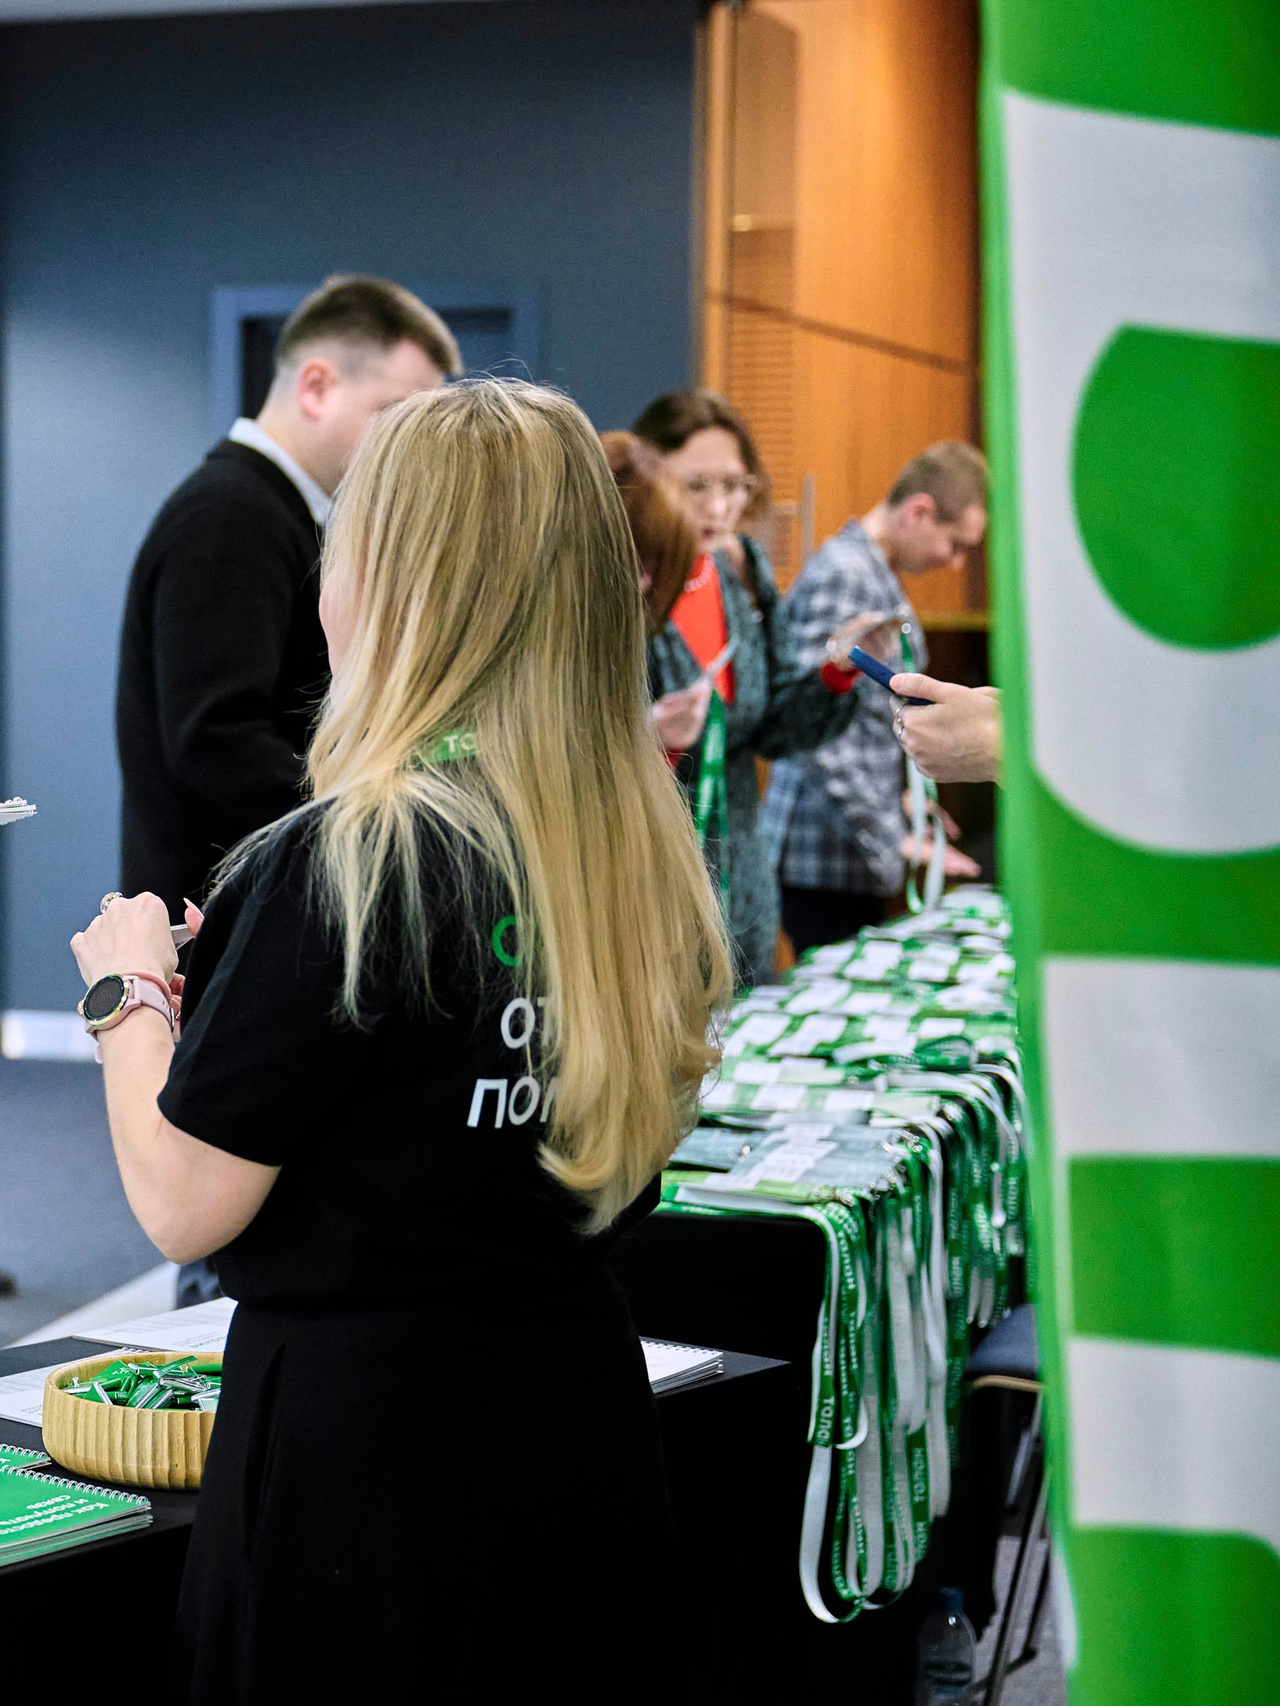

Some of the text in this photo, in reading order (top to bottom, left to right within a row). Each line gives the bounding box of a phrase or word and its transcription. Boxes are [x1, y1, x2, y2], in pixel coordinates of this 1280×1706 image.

[26, 1494, 71, 1510] связь
[72, 1502, 109, 1514] Как
[0, 1503, 76, 1526] получать
